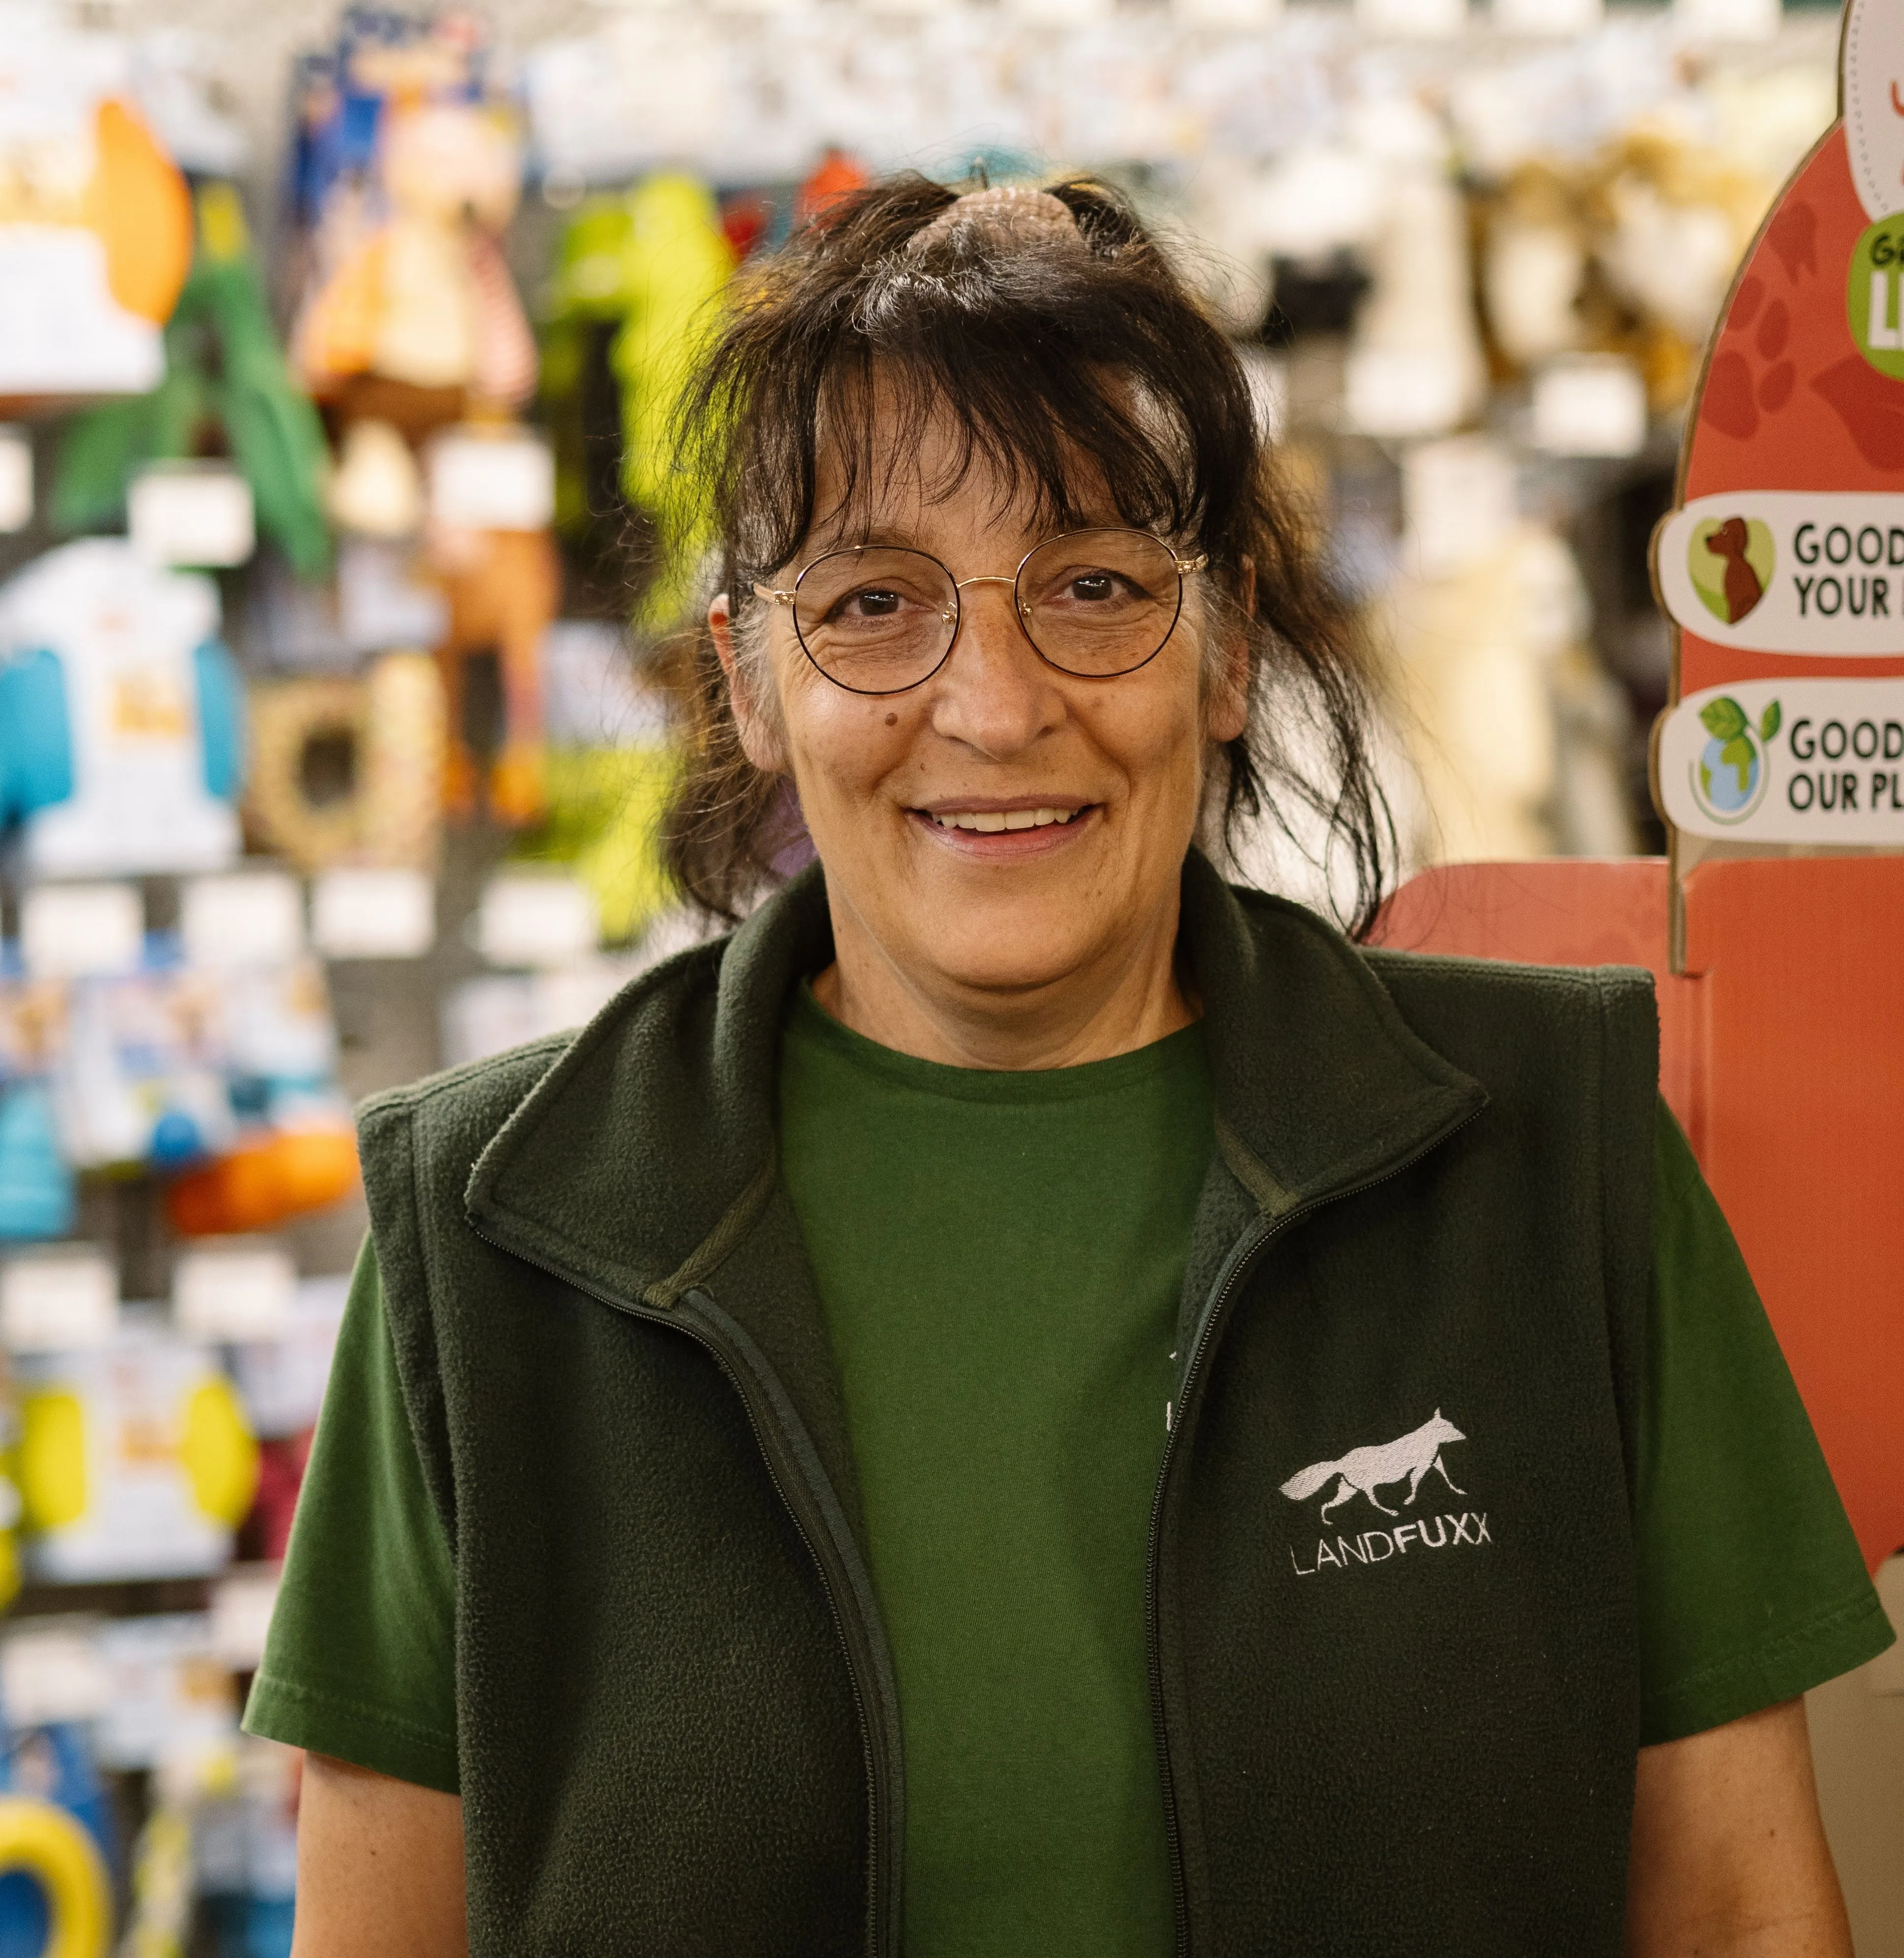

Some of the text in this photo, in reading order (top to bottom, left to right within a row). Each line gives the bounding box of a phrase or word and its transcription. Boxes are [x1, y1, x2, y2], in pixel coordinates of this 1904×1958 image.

[1870, 232, 1904, 266] G
[1869, 271, 1904, 347] L
[1794, 525, 1904, 565] GOOD
[1795, 577, 1888, 615] YOUR
[1790, 720, 1904, 759] GOOD
[1788, 773, 1858, 810] OUR
[1290, 1513, 1492, 1575] LANDFUXX
